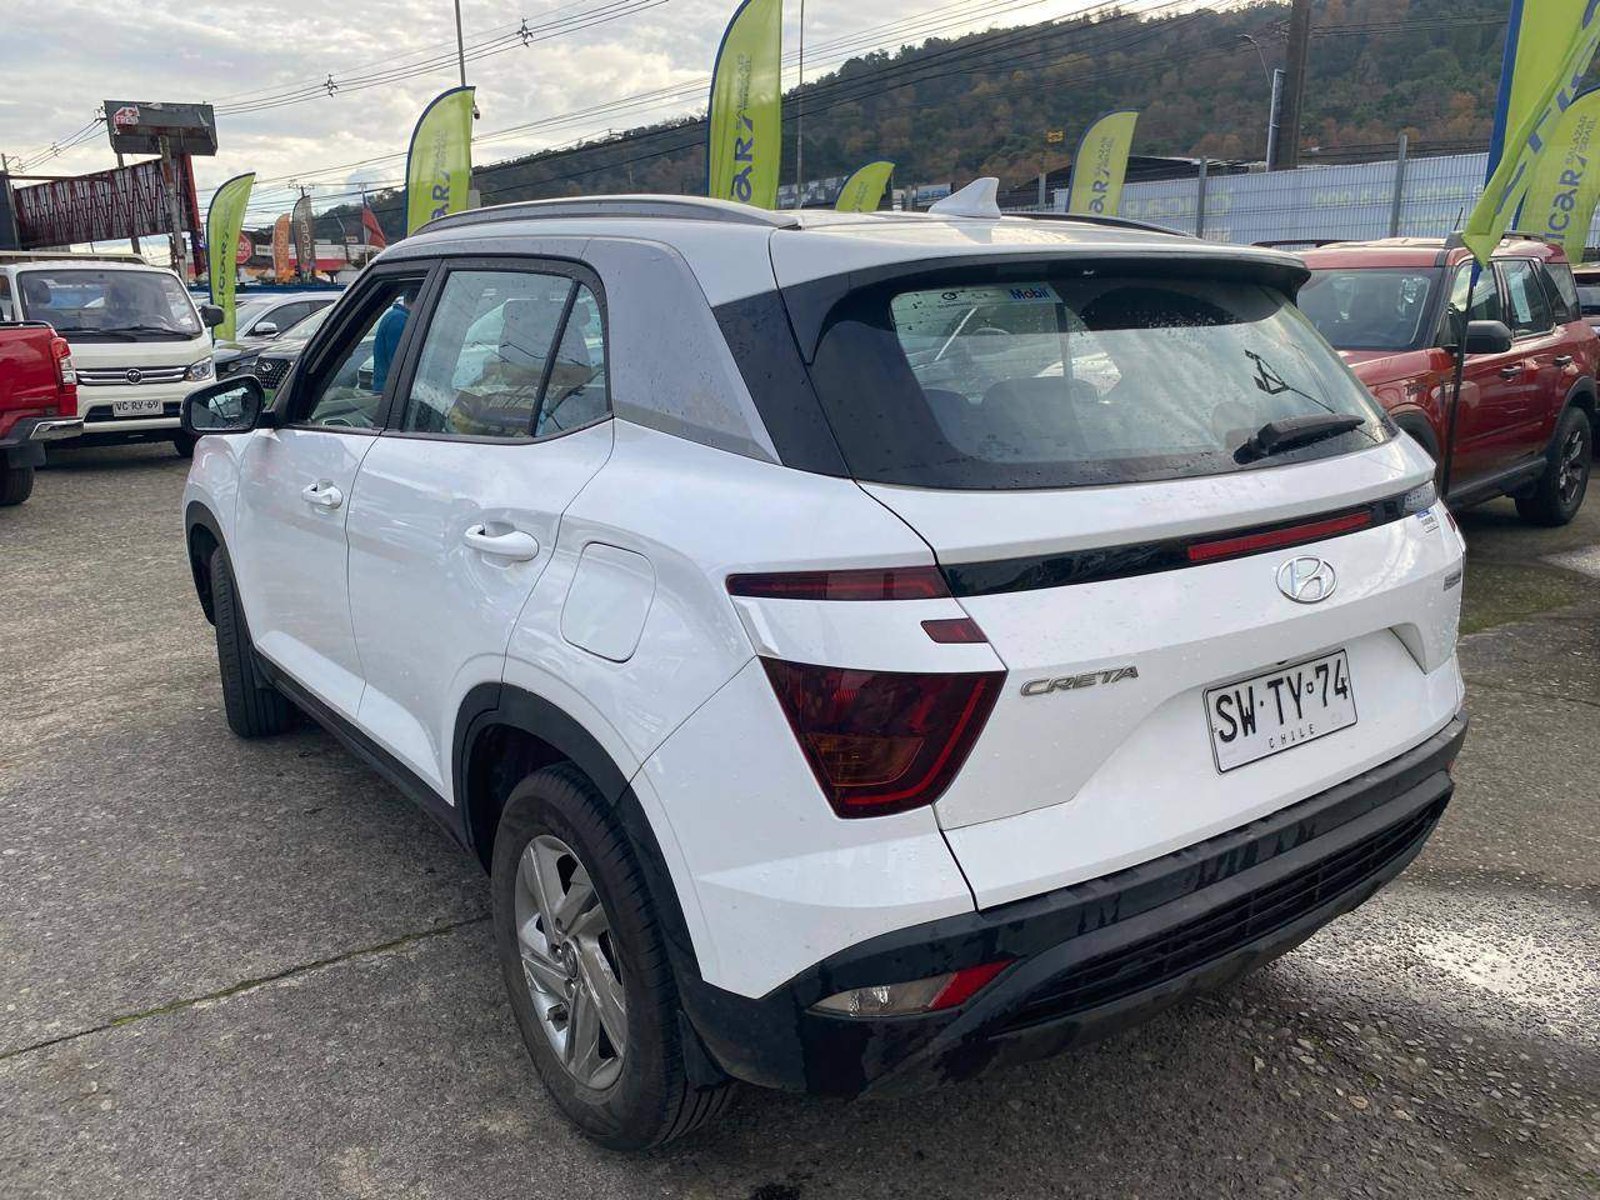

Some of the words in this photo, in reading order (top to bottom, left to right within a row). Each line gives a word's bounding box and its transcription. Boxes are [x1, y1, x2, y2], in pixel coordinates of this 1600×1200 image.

[1009, 286, 1051, 300] Mobil
[1019, 665, 1139, 697] CRETA
[1268, 723, 1316, 748] CHILE
